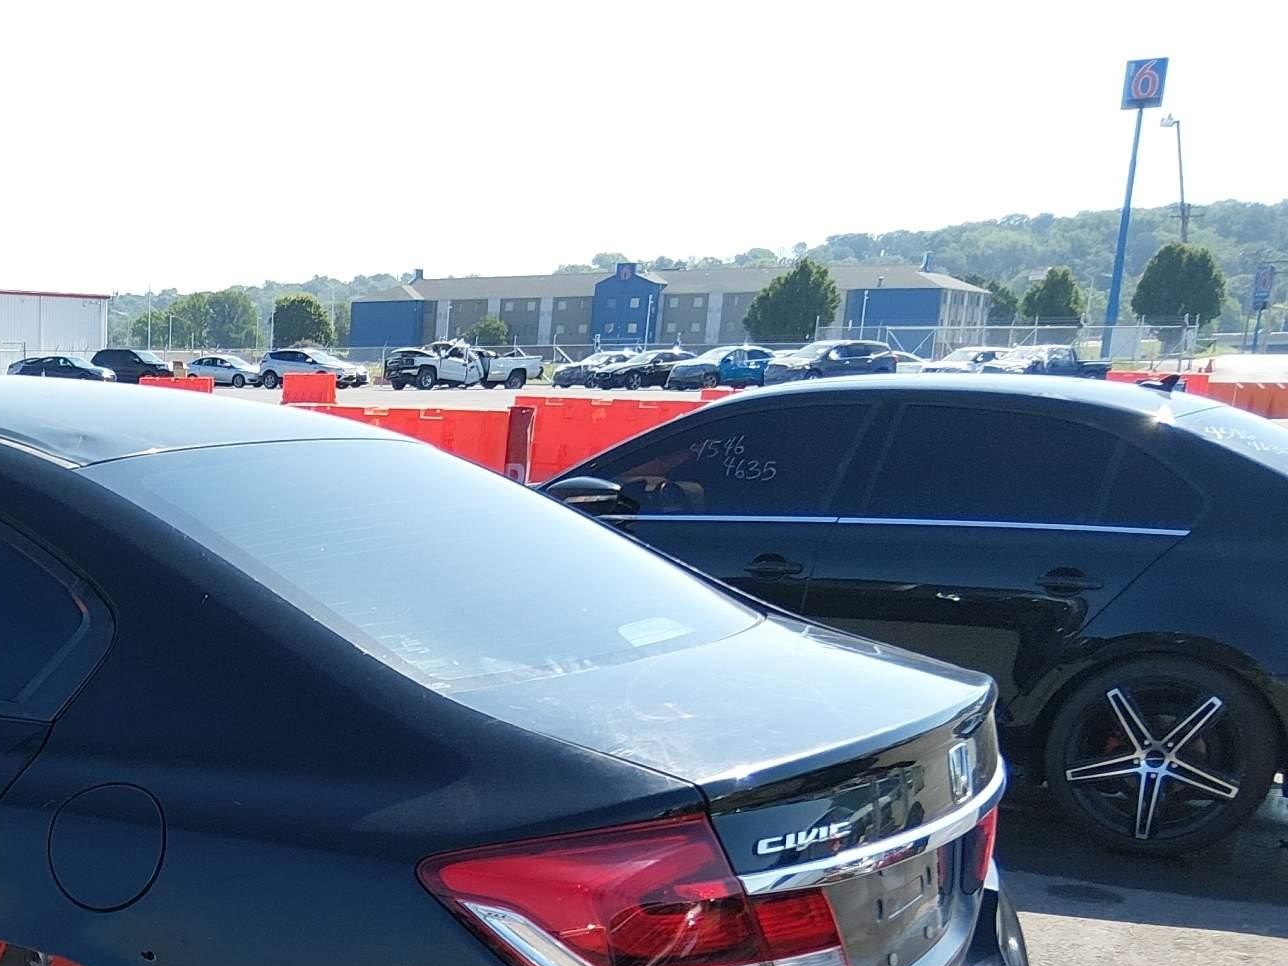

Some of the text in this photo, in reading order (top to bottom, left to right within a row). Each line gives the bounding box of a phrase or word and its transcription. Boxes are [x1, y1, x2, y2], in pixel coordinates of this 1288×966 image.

[1131, 59, 1159, 99] 6
[722, 455, 777, 481] 4635
[757, 821, 852, 855] CIVIC
